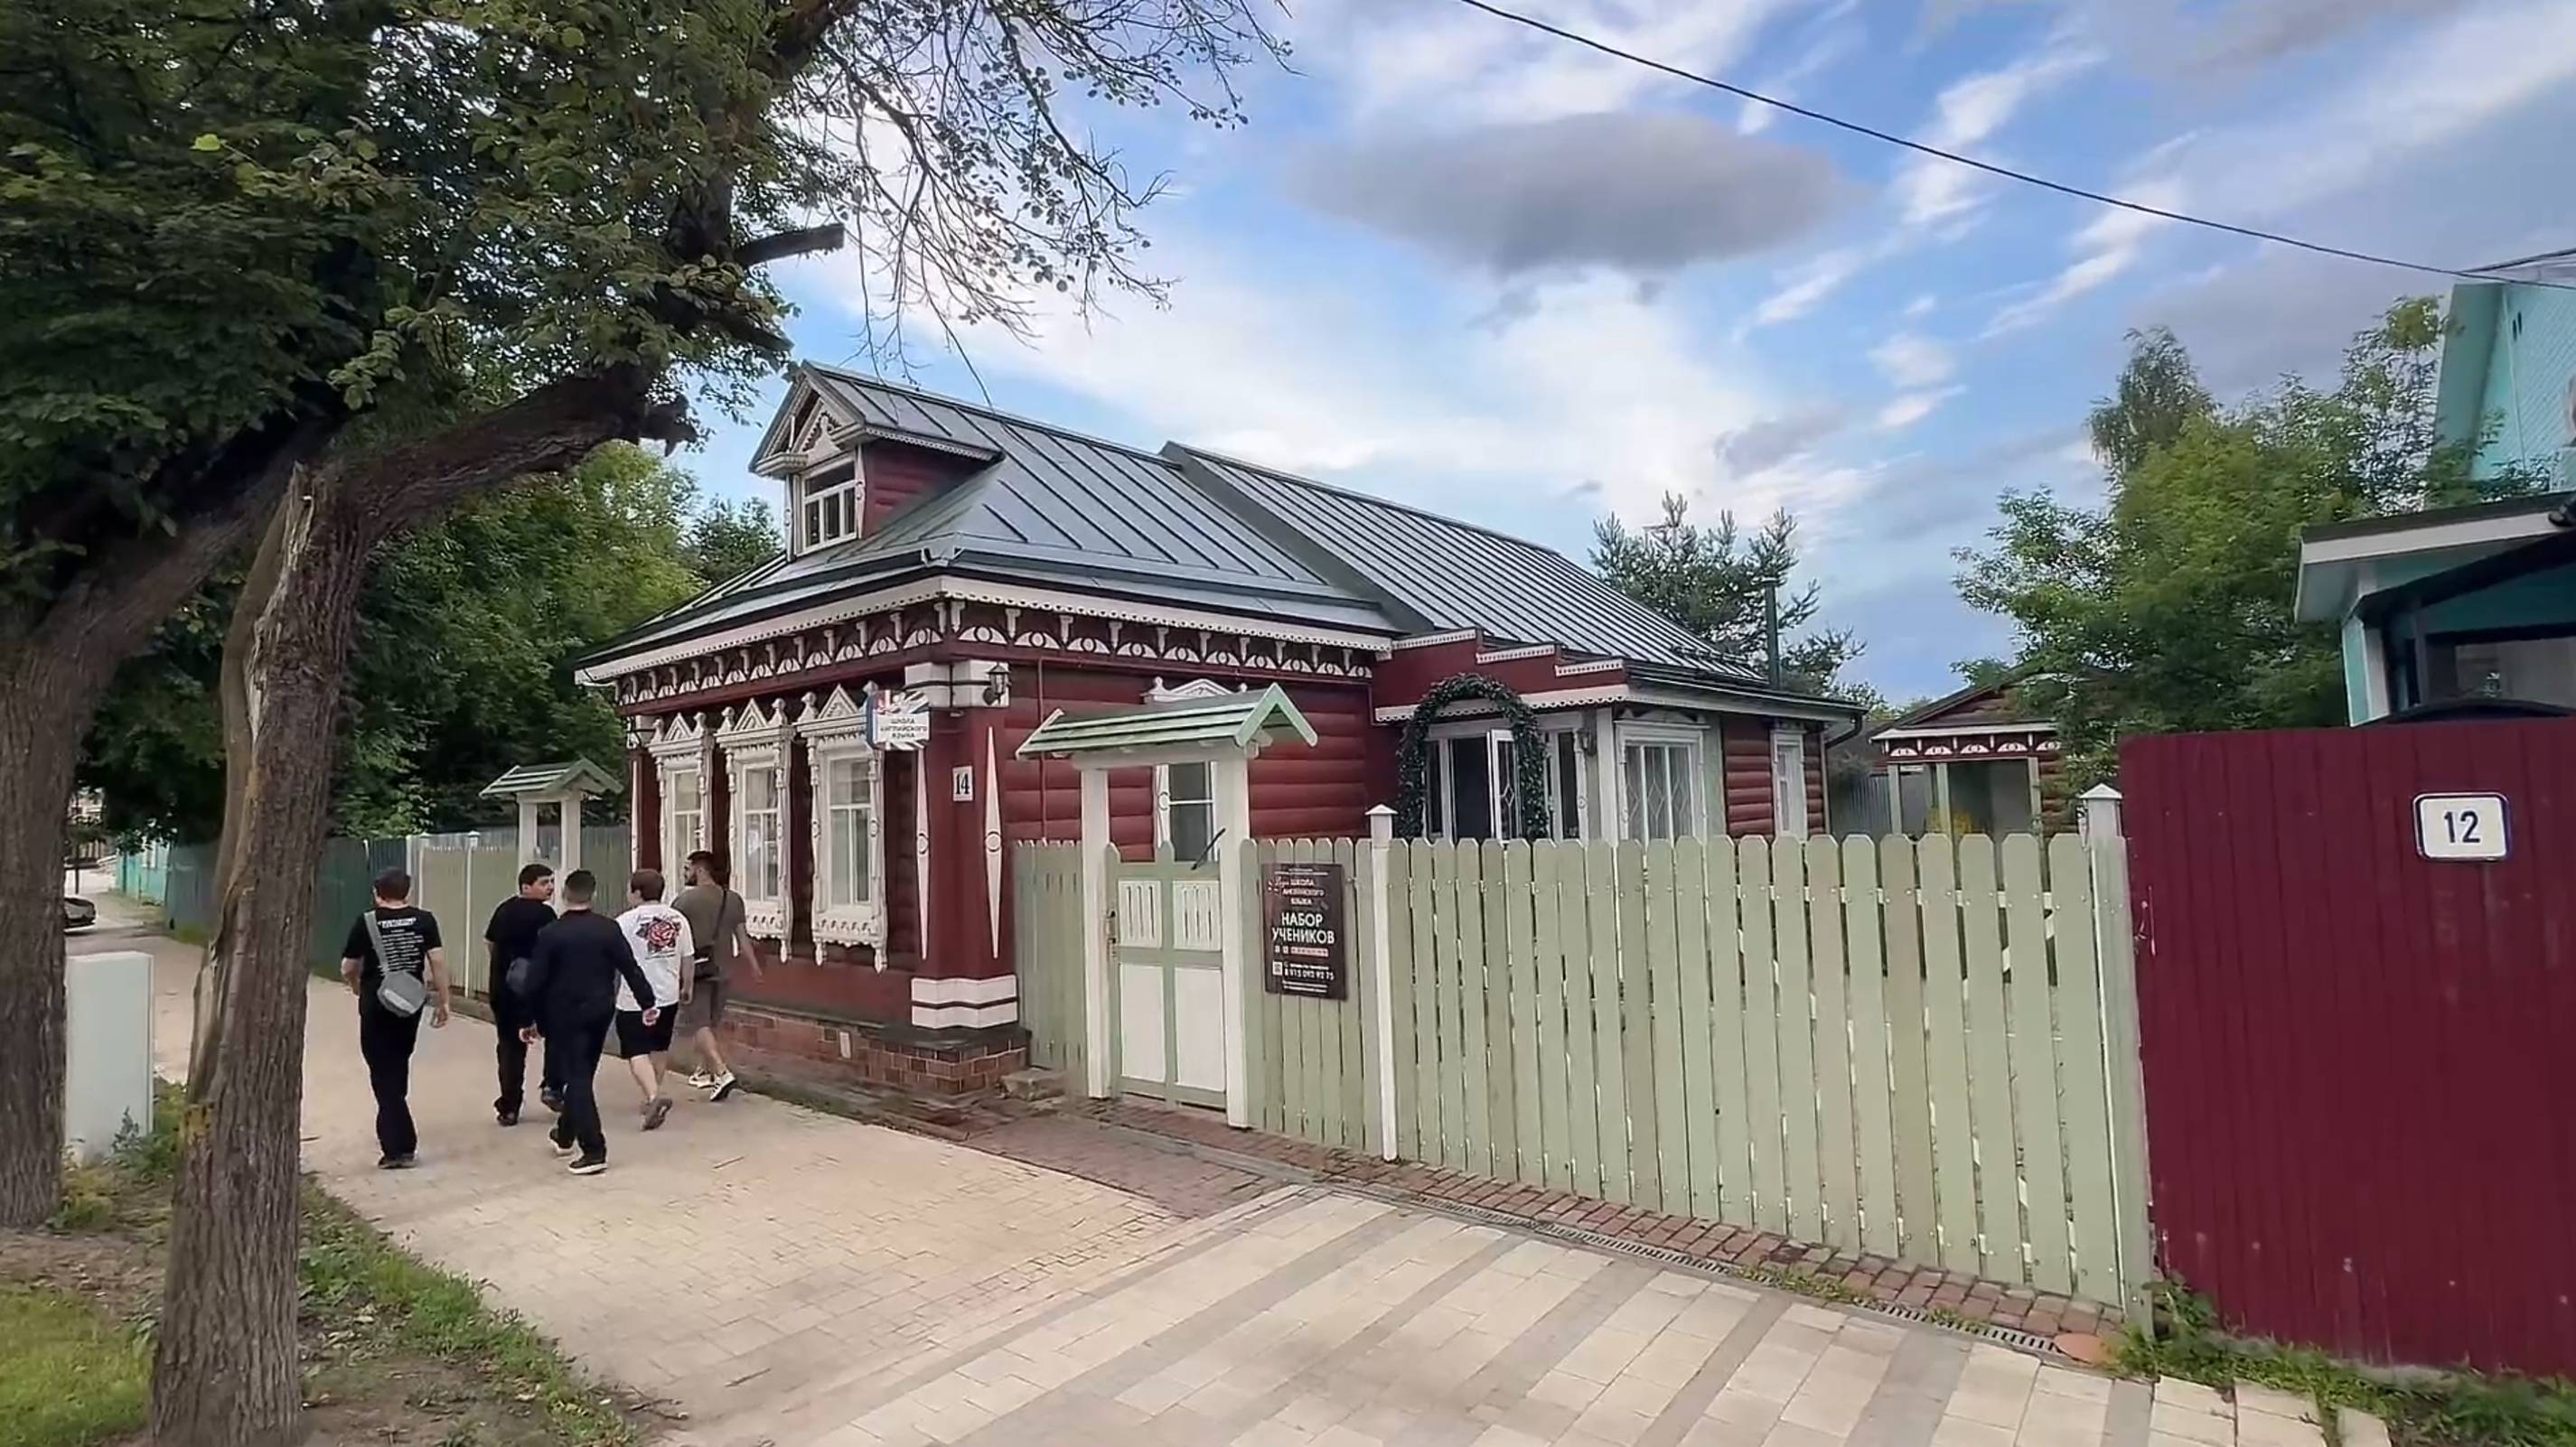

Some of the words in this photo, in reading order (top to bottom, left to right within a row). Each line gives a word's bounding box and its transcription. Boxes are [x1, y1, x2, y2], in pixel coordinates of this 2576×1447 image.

[955, 772, 970, 795] 14
[2443, 810, 2481, 844] 12
[1281, 911, 1324, 928] НАБОР
[1271, 927, 1335, 945] УЧЕНИКОВ
